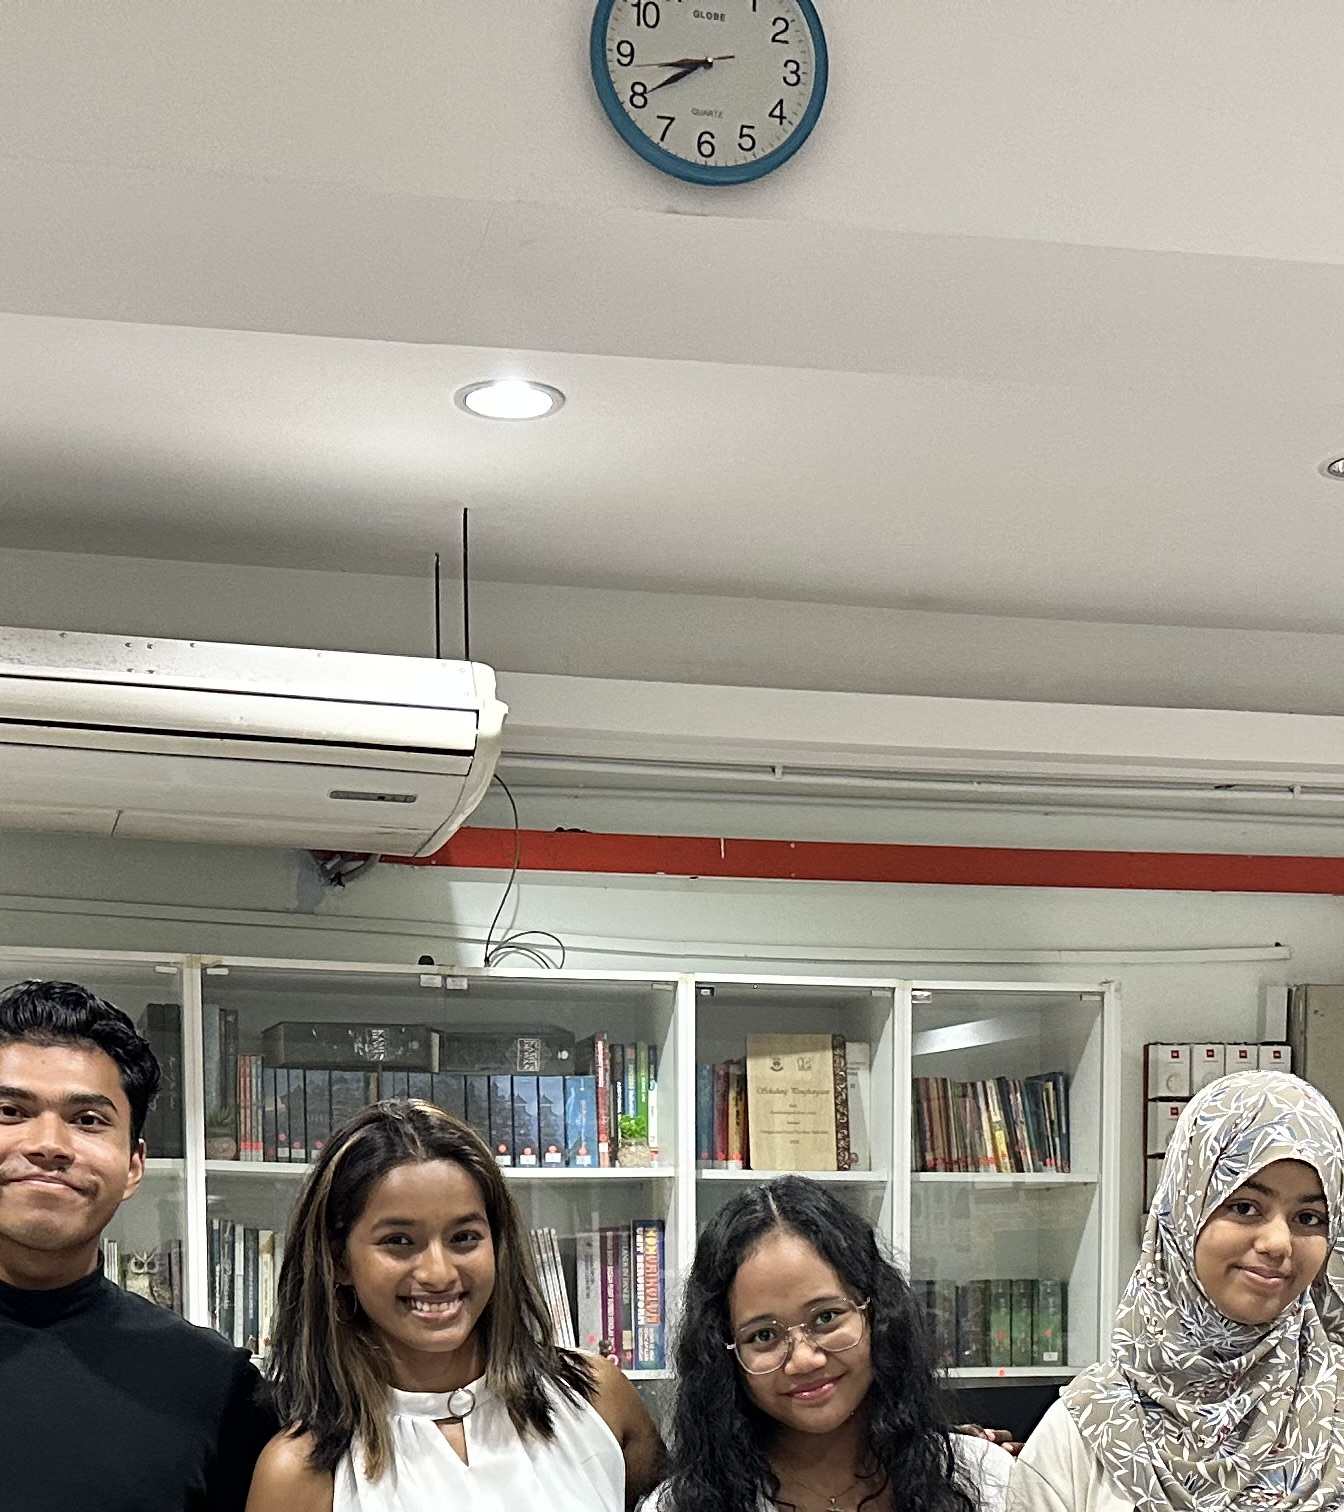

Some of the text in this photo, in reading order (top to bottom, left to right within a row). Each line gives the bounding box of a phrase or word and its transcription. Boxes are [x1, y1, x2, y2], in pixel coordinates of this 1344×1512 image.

[631, 1, 660, 28] 10
[693, 10, 725, 21] GLOBE
[771, 17, 790, 44] 2
[616, 40, 635, 67] 9
[782, 59, 801, 86] 3
[629, 82, 648, 109] 8
[691, 108, 723, 118] QUARTZ
[768, 98, 787, 125] 4
[657, 115, 675, 142] 7
[738, 124, 756, 151] 5
[697, 131, 715, 158] 6
